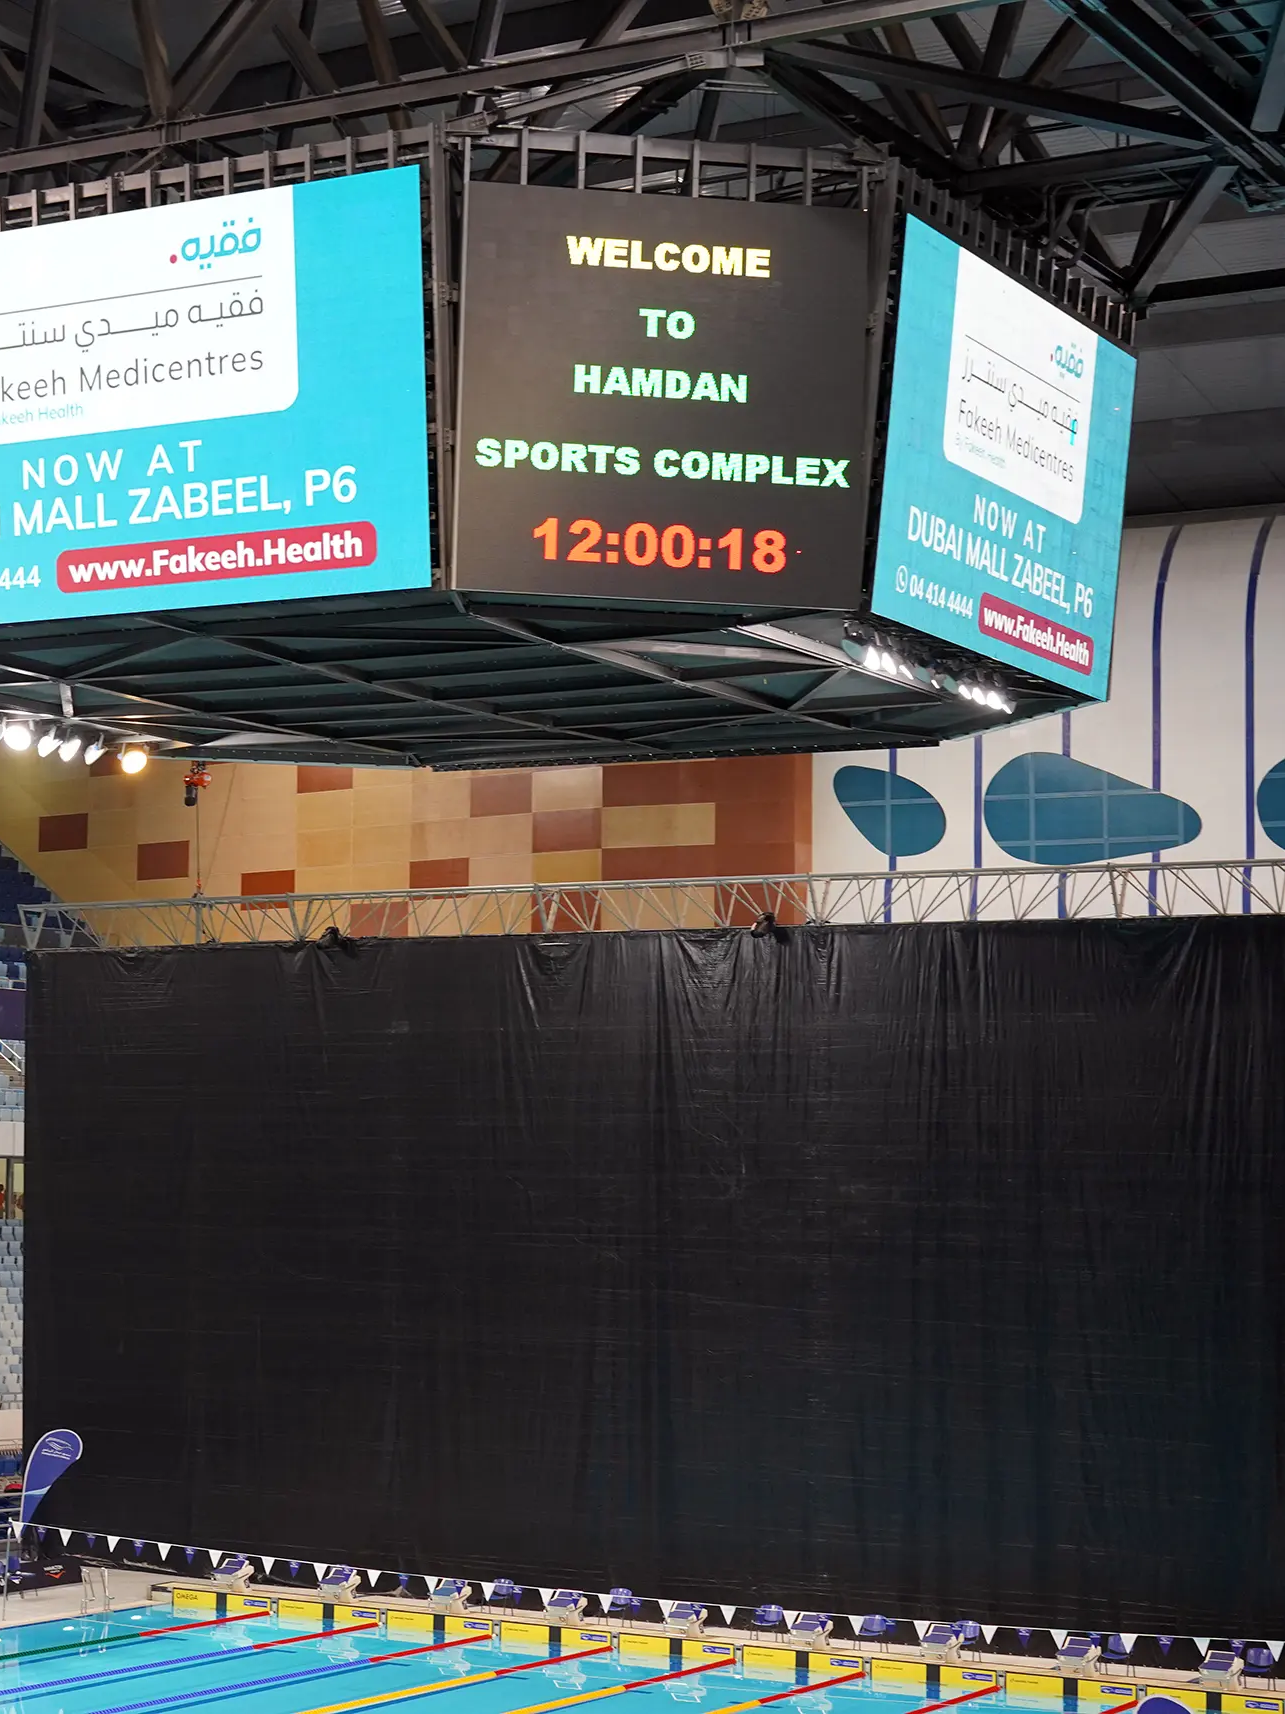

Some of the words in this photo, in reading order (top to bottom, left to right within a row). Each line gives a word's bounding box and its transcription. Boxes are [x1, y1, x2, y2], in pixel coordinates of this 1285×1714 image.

[566, 235, 771, 278] WELCOME
[188, 289, 263, 328] فقيه
[639, 308, 695, 340] TO
[80, 350, 264, 392] Medicentres
[573, 364, 748, 403] HAMDAN
[38, 404, 83, 421] Health
[22, 449, 123, 490] NOW
[147, 440, 203, 477] AT
[474, 437, 642, 476] SPORTS
[654, 449, 851, 488] COMPLEX
[958, 399, 1002, 445] Fakeeh
[1006, 424, 1074, 482] Medicentres
[13, 492, 118, 538] MALL
[128, 475, 292, 526] ZABEEL,
[305, 465, 358, 506] P6
[973, 494, 1018, 540] NOW
[1023, 520, 1047, 553] AT
[68, 530, 364, 585] www.Fakeeh.Health
[532, 517, 787, 575] 12:00:18
[907, 505, 964, 561] DUBAI
[965, 532, 1009, 582] MALL
[1011, 554, 1071, 614] ZABEEL,
[1074, 582, 1094, 619] P6
[909, 574, 925, 600] 04
[925, 581, 946, 609] 414
[946, 591, 974, 619] 4444
[983, 607, 1090, 667] www.Fakeeh.Health
